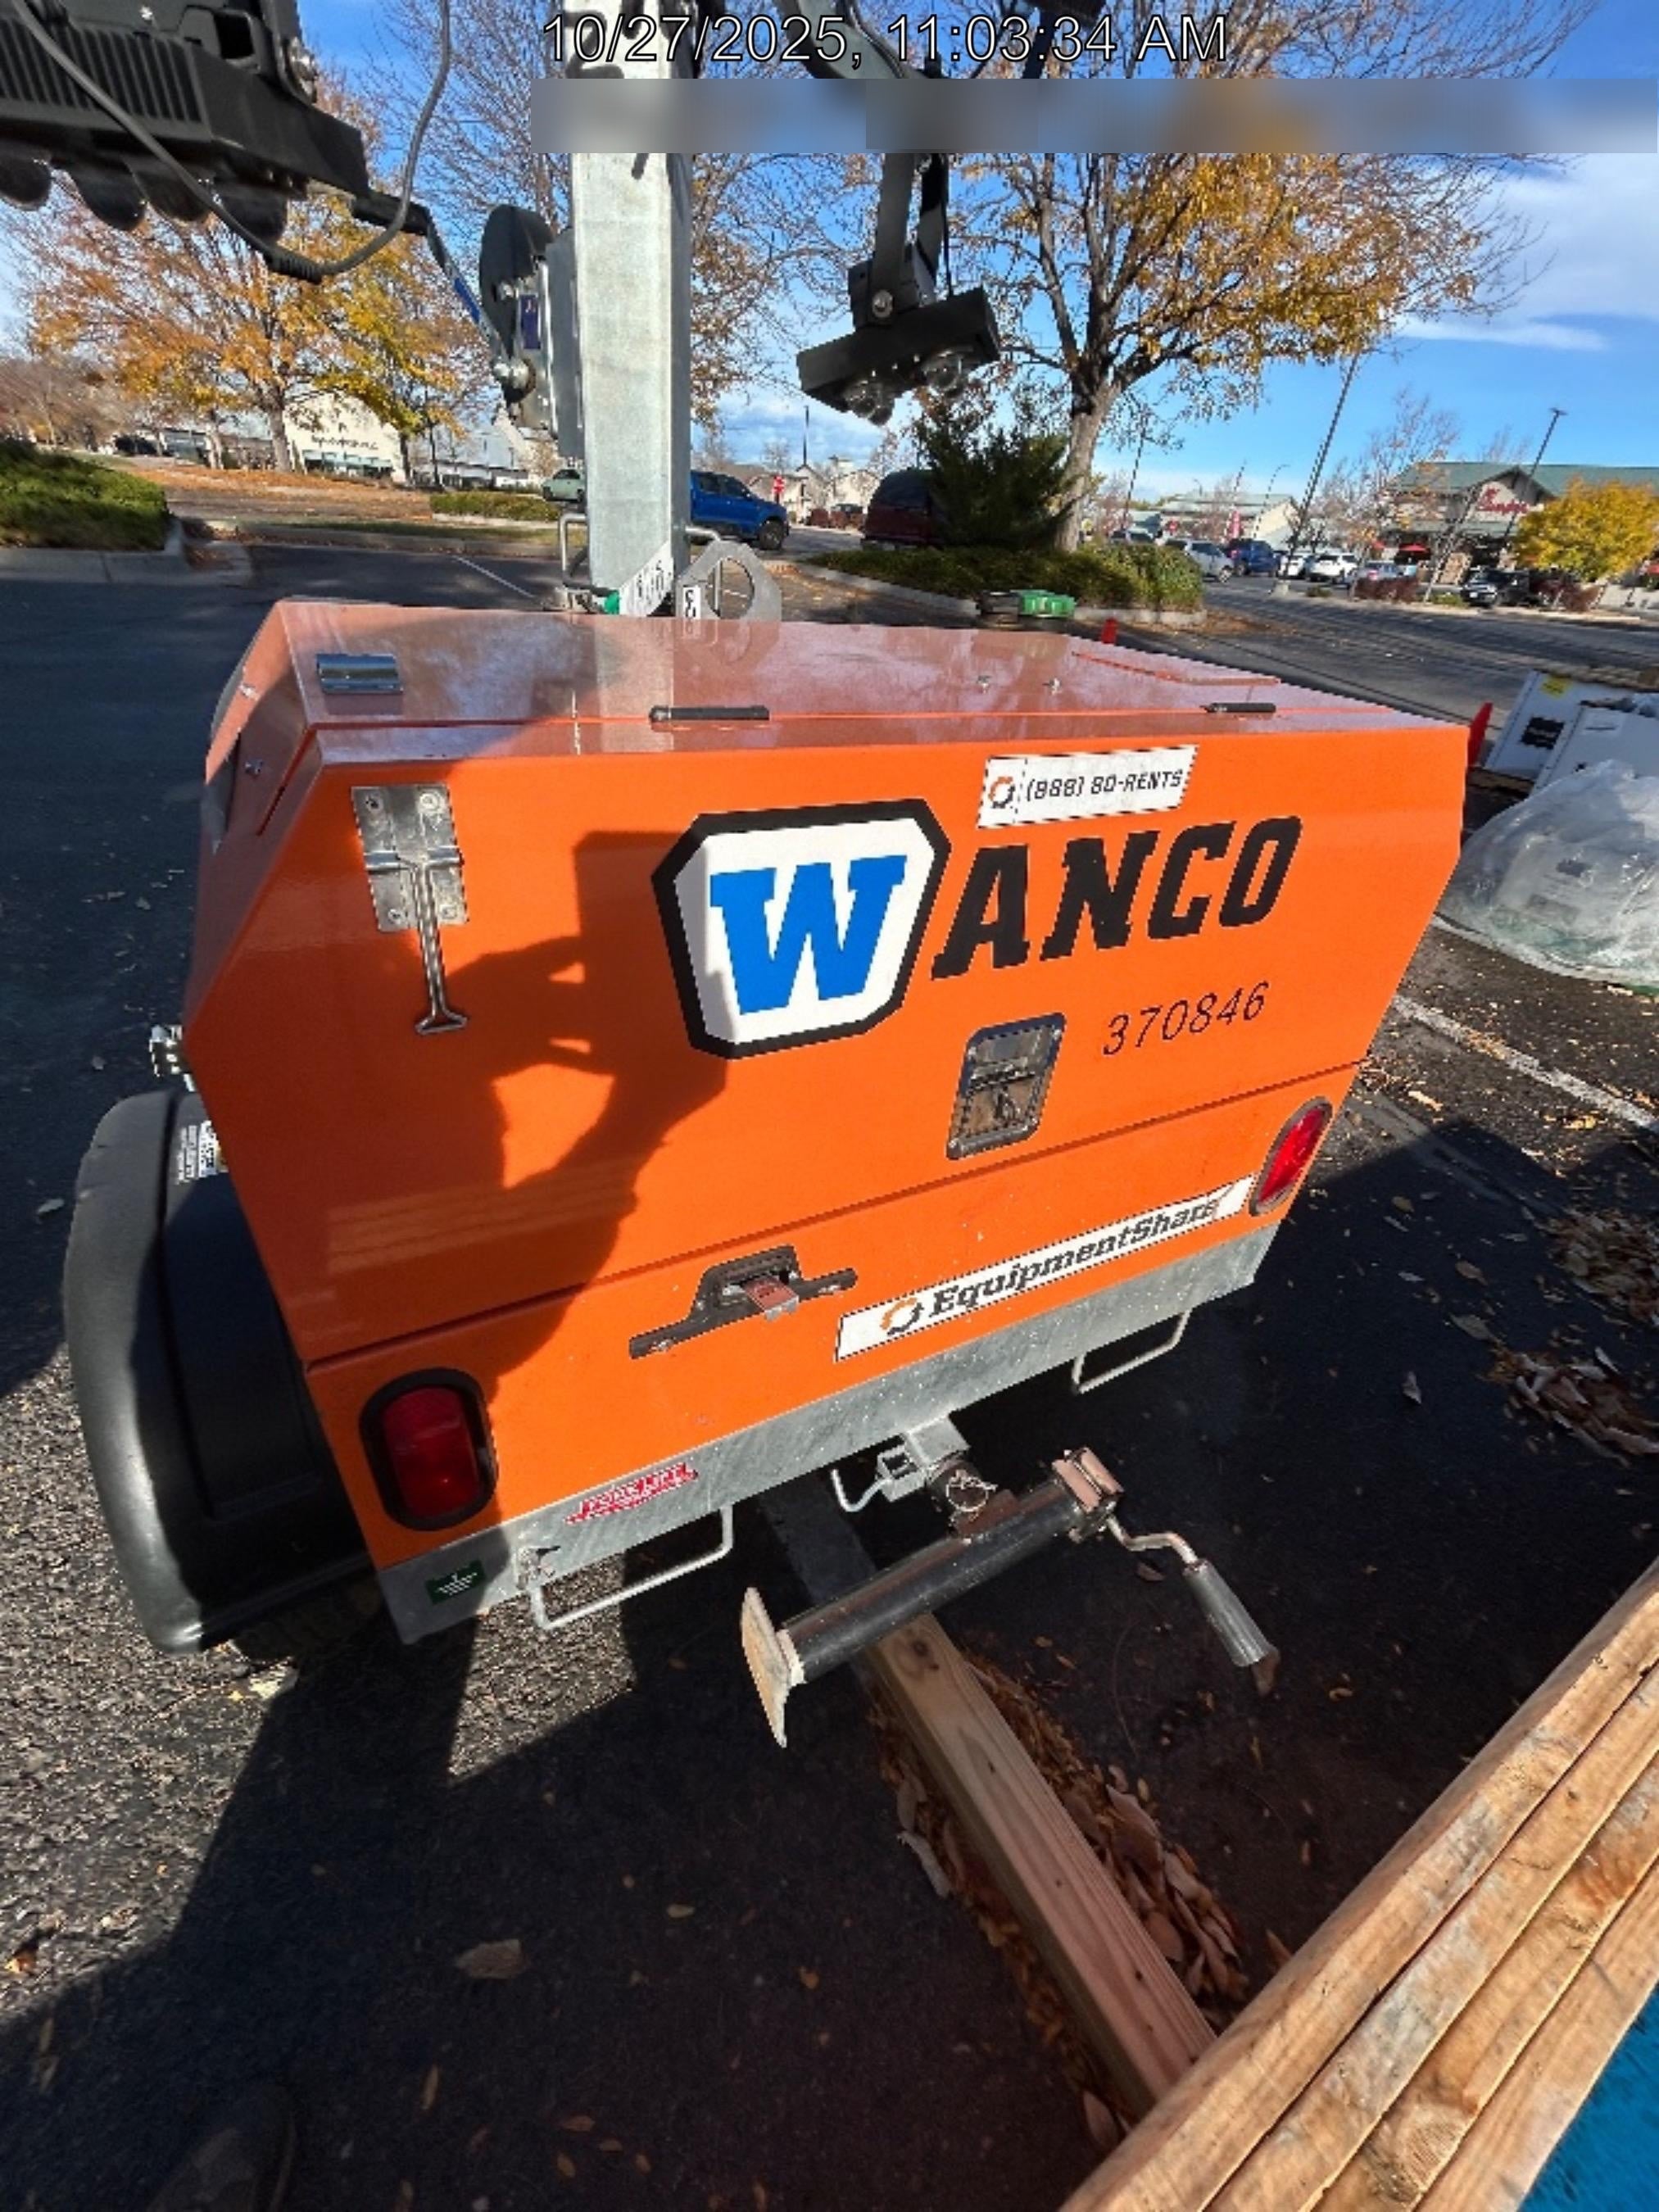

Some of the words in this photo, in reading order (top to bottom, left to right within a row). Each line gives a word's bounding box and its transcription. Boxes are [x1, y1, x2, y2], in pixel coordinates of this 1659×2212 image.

[1026, 777, 1085, 802] (888)
[709, 815, 1303, 1016] WANCO
[1103, 980, 1270, 1055] 370846
